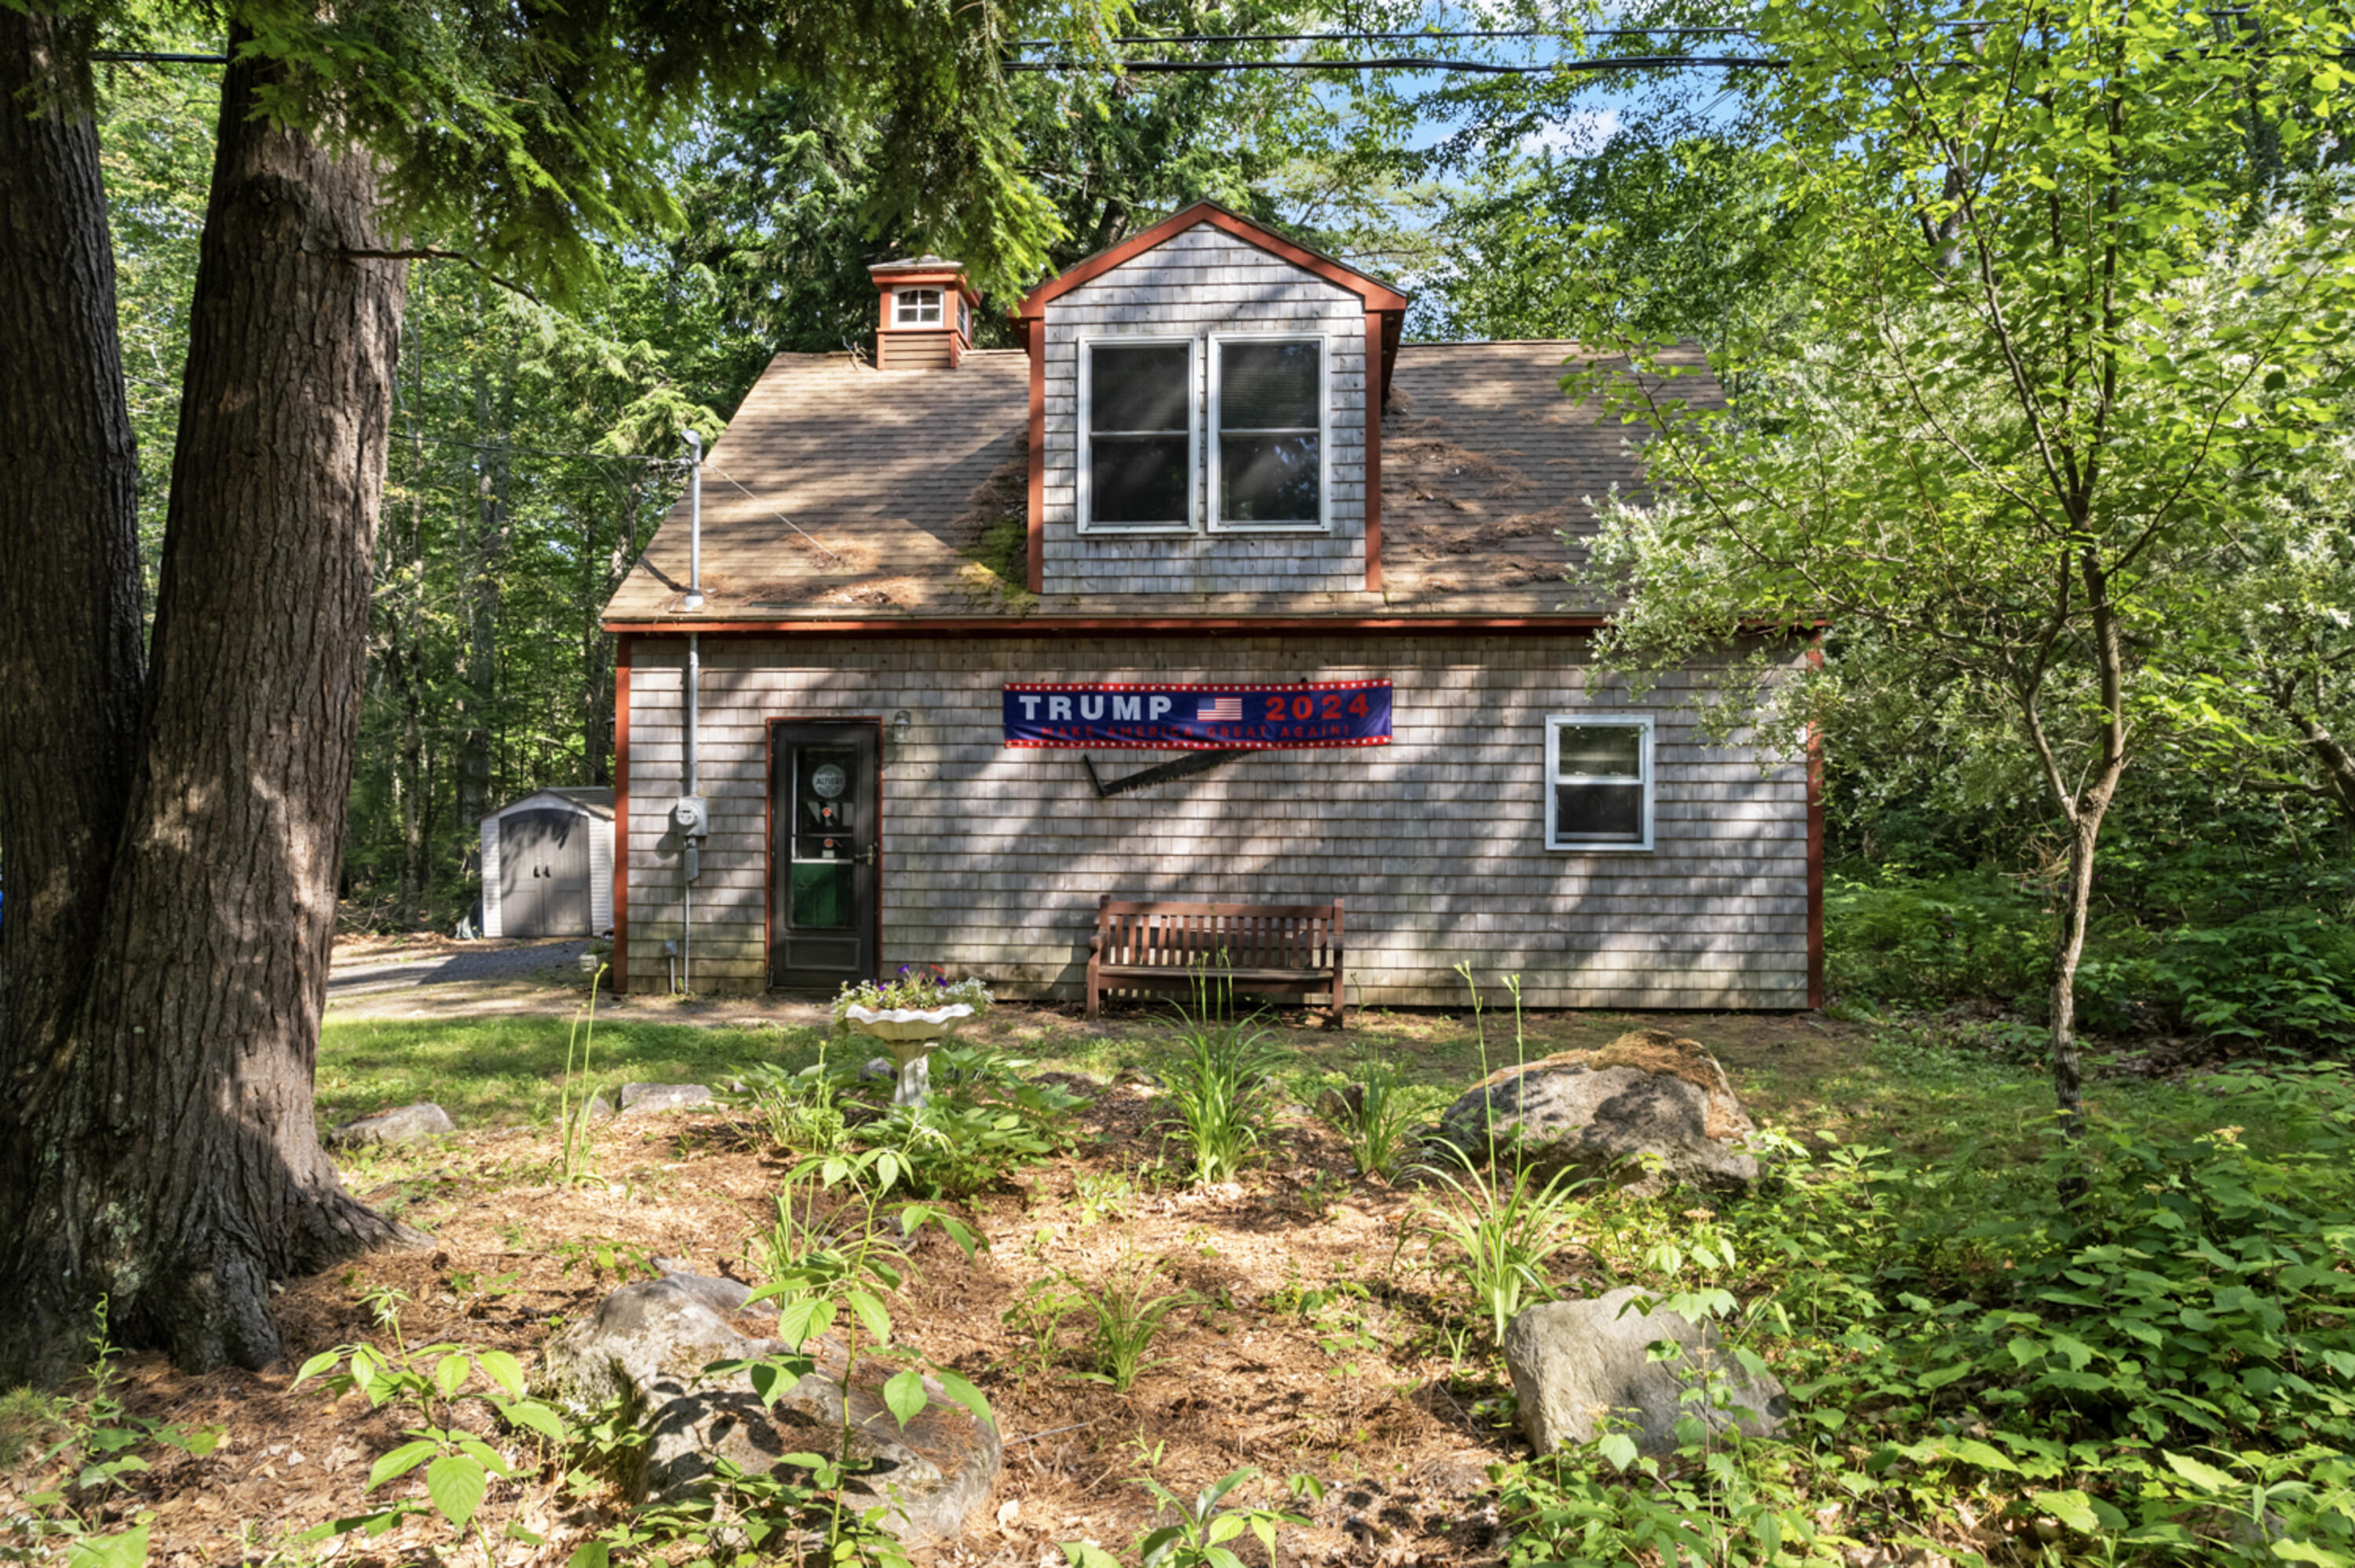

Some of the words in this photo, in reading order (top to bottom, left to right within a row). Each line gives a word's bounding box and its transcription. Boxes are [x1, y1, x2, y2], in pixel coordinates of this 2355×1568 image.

[1019, 695, 1172, 720] TRUMP
[1265, 693, 1370, 720] 2024
[1041, 725, 1094, 737] MAKE
[1106, 726, 1193, 738] AMERICA
[1206, 725, 1267, 738] GREAT
[1280, 724, 1349, 738] AGAIN!
